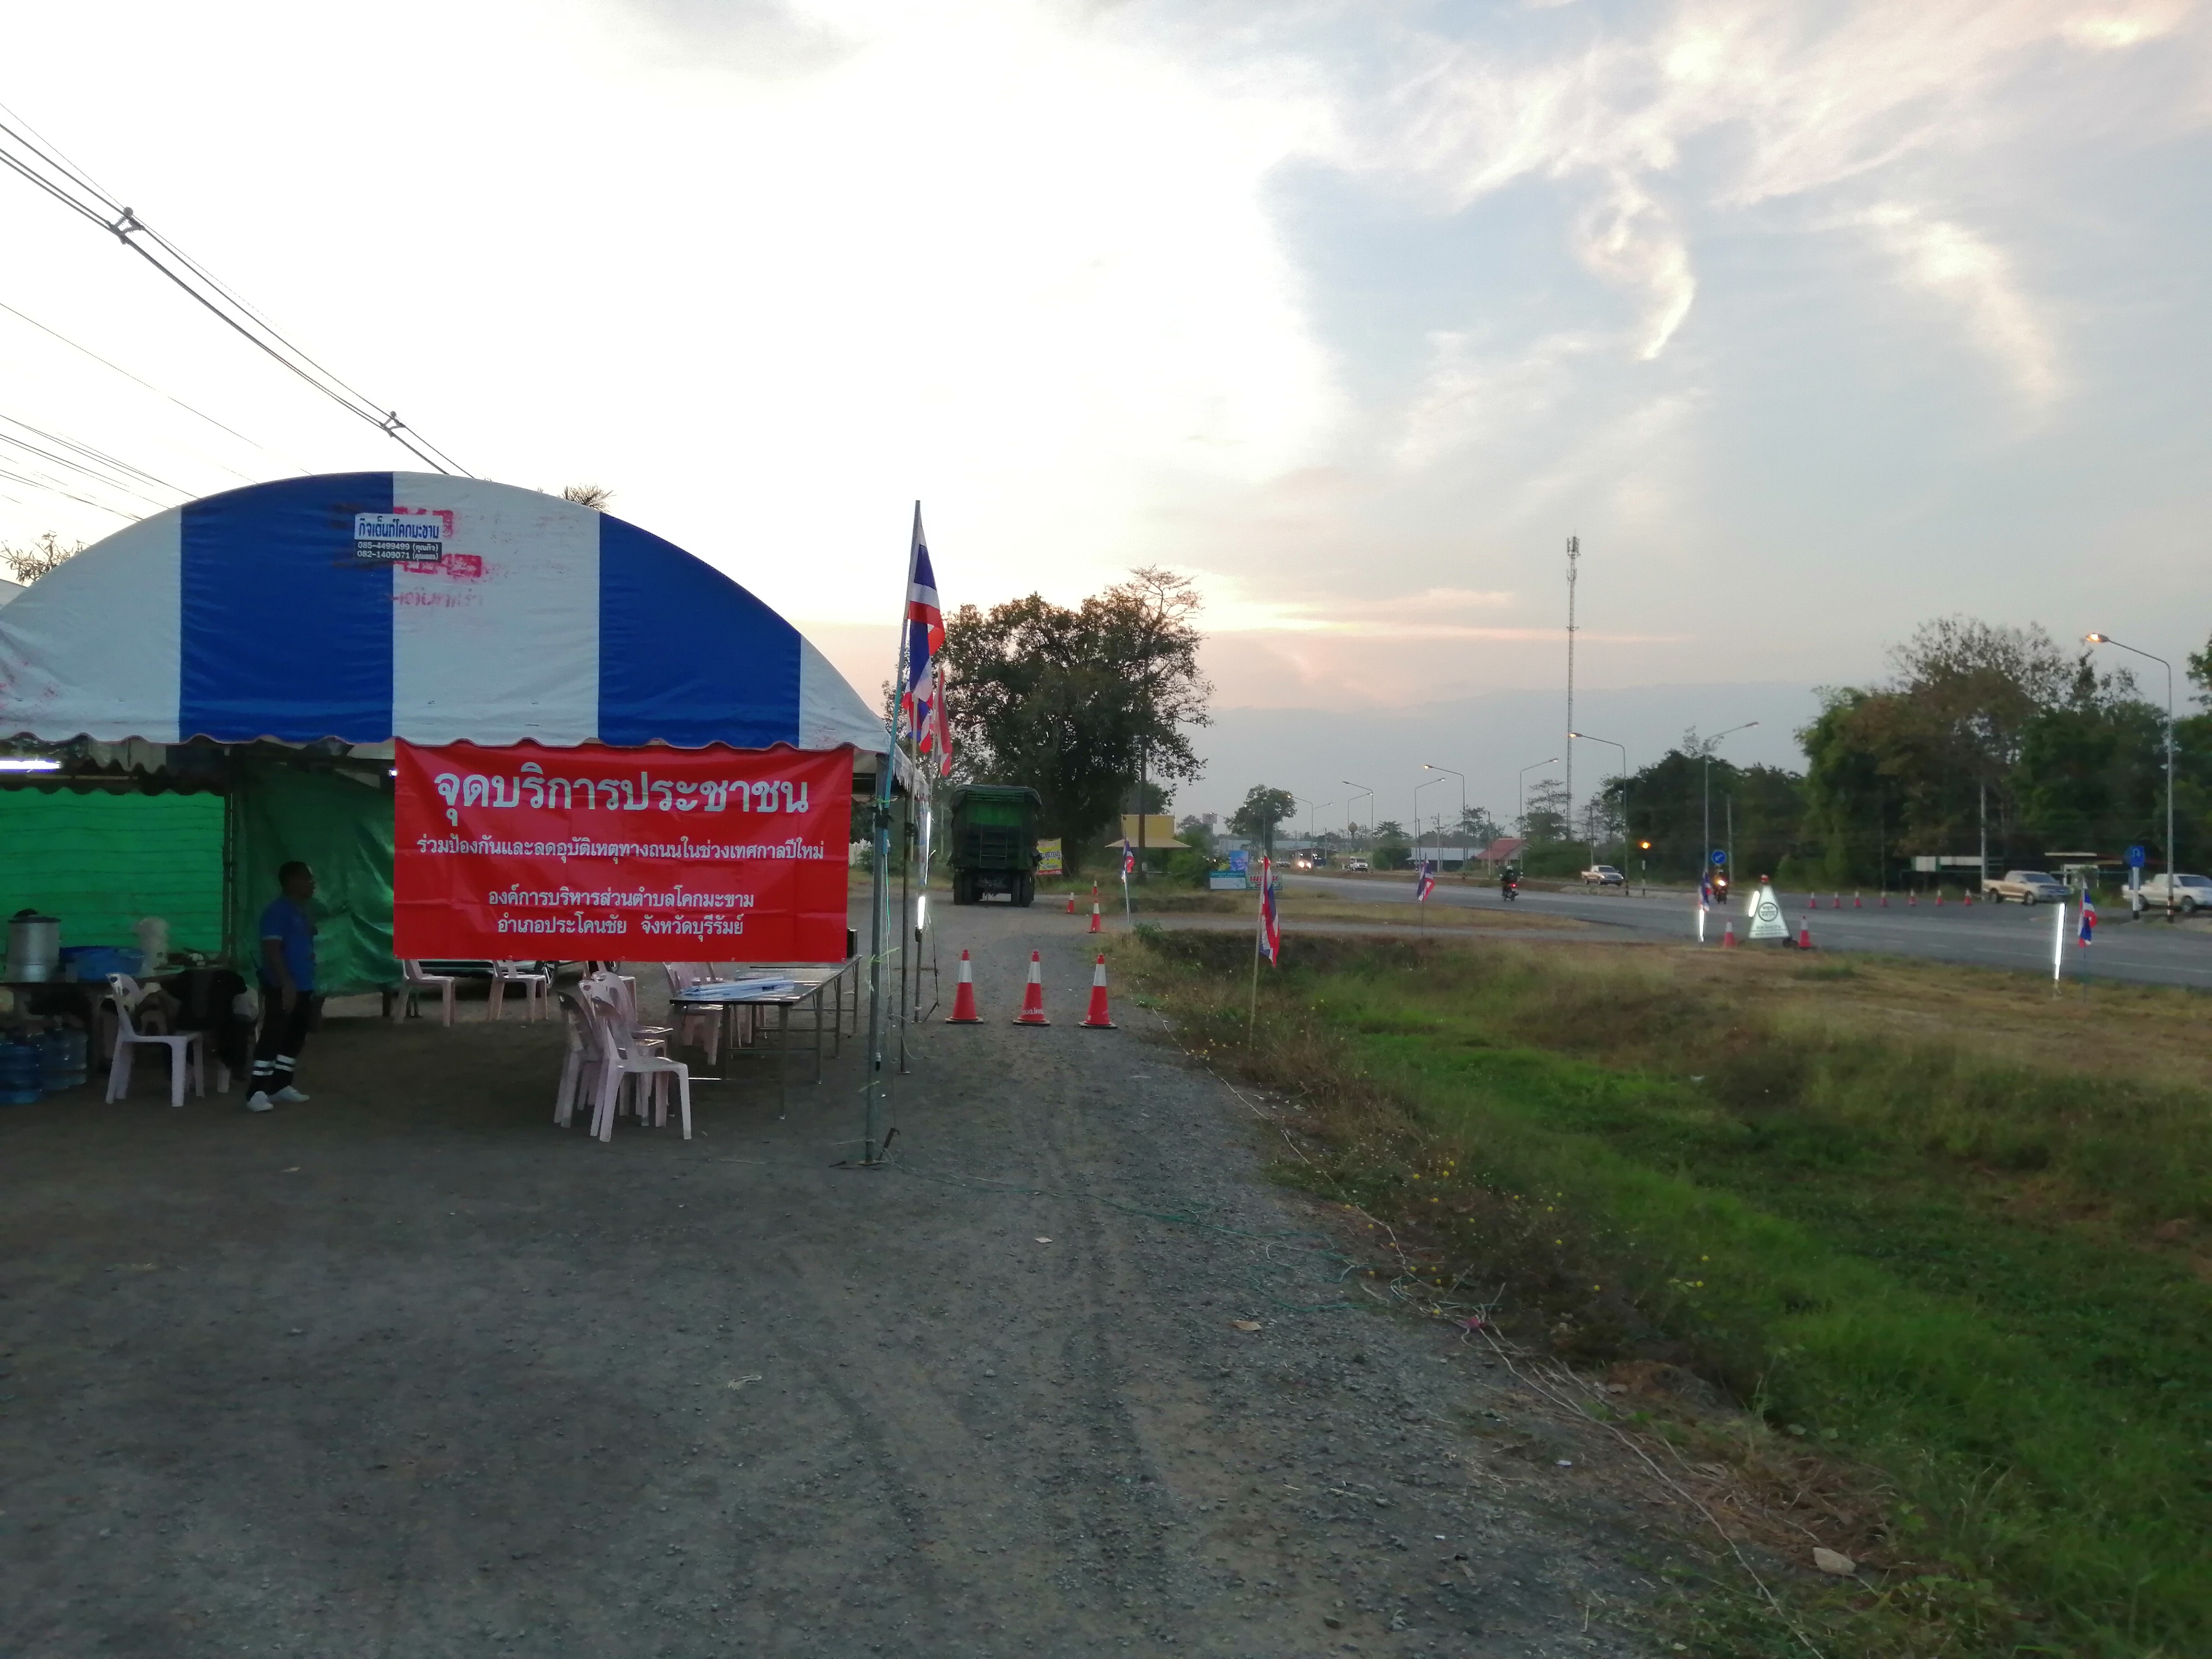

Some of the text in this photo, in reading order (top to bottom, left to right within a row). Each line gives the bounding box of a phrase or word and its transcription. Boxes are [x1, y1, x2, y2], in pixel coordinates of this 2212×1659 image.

[357, 541, 410, 550] 085-4499499
[434, 762, 808, 826] จุดบริการประชาชน
[417, 833, 824, 864] ร่วมป้องกันและลดอุบัติเหตุทางถนนในช่วงเทศกาลปีใหม่
[489, 884, 754, 908] องค์การบริหารส่วนตำบลโคกมะขาม
[498, 912, 744, 942] อำเภอประโคนชัย จังหวัดบุรีรัมย์
